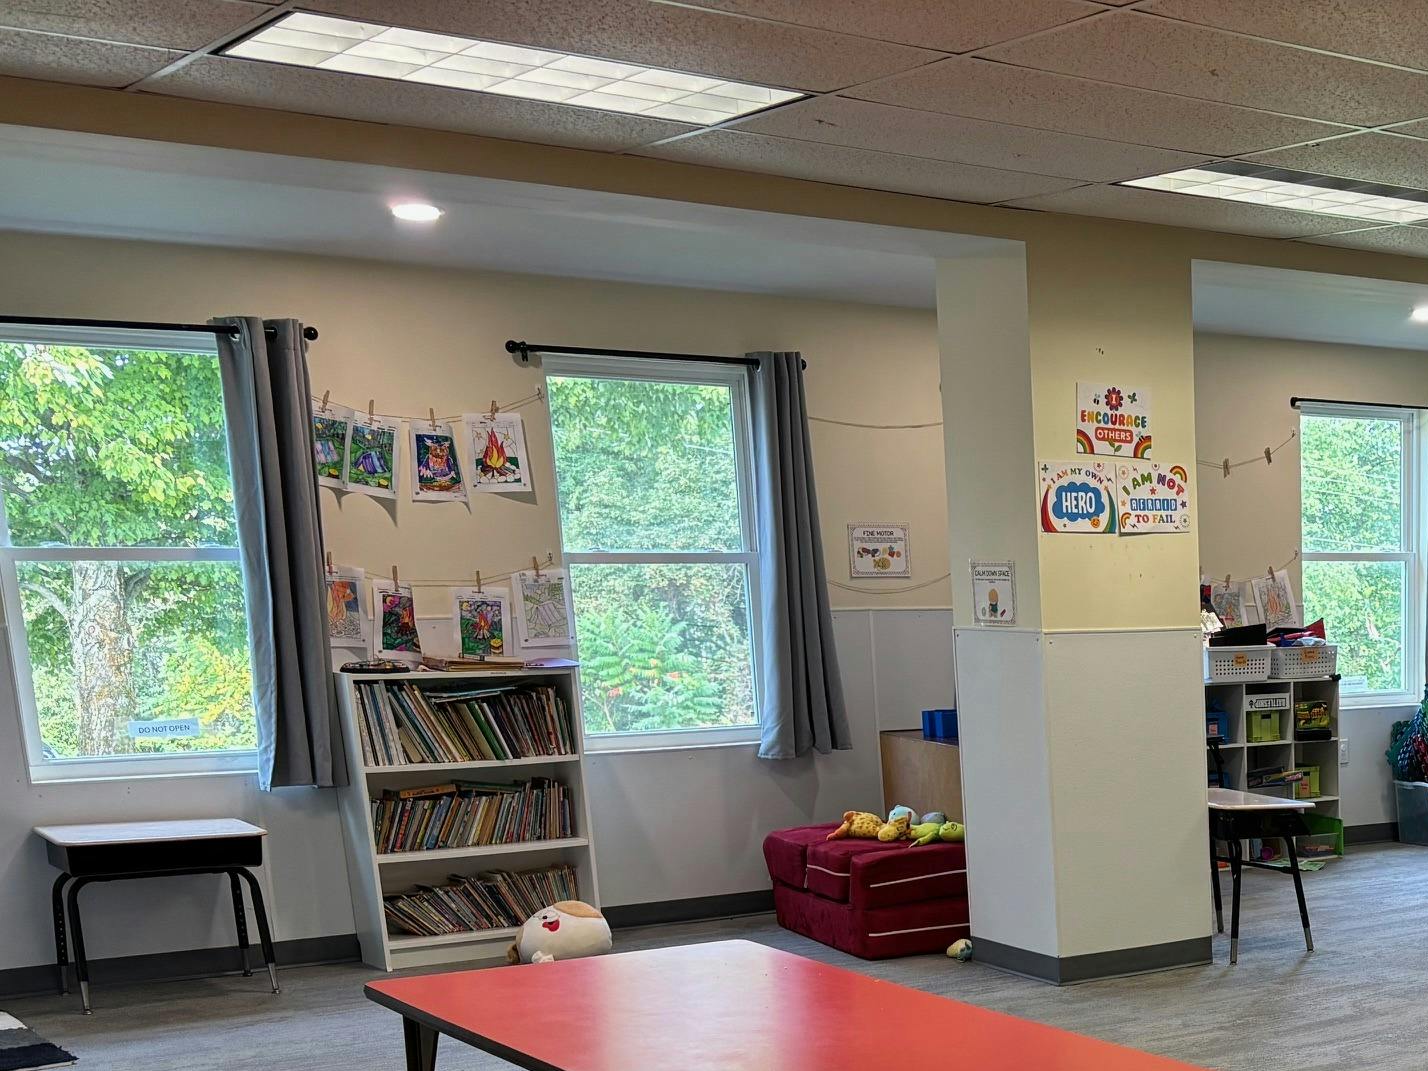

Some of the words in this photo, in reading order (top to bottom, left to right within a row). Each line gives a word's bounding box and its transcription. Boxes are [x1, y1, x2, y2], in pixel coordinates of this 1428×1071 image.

[1111, 395, 1117, 404] I
[1080, 409, 1147, 428] ENCOURAGE
[1097, 429, 1131, 440] OTHERS
[1056, 469, 1069, 480] AM
[1085, 470, 1104, 484] OWN
[1122, 485, 1131, 496] I
[1131, 472, 1153, 489] AM
[1156, 473, 1185, 496] NOT
[1061, 491, 1096, 514] HERO
[1131, 498, 1177, 511] AFRAID
[1134, 514, 1149, 524] TO
[1152, 514, 1176, 524] FAIL
